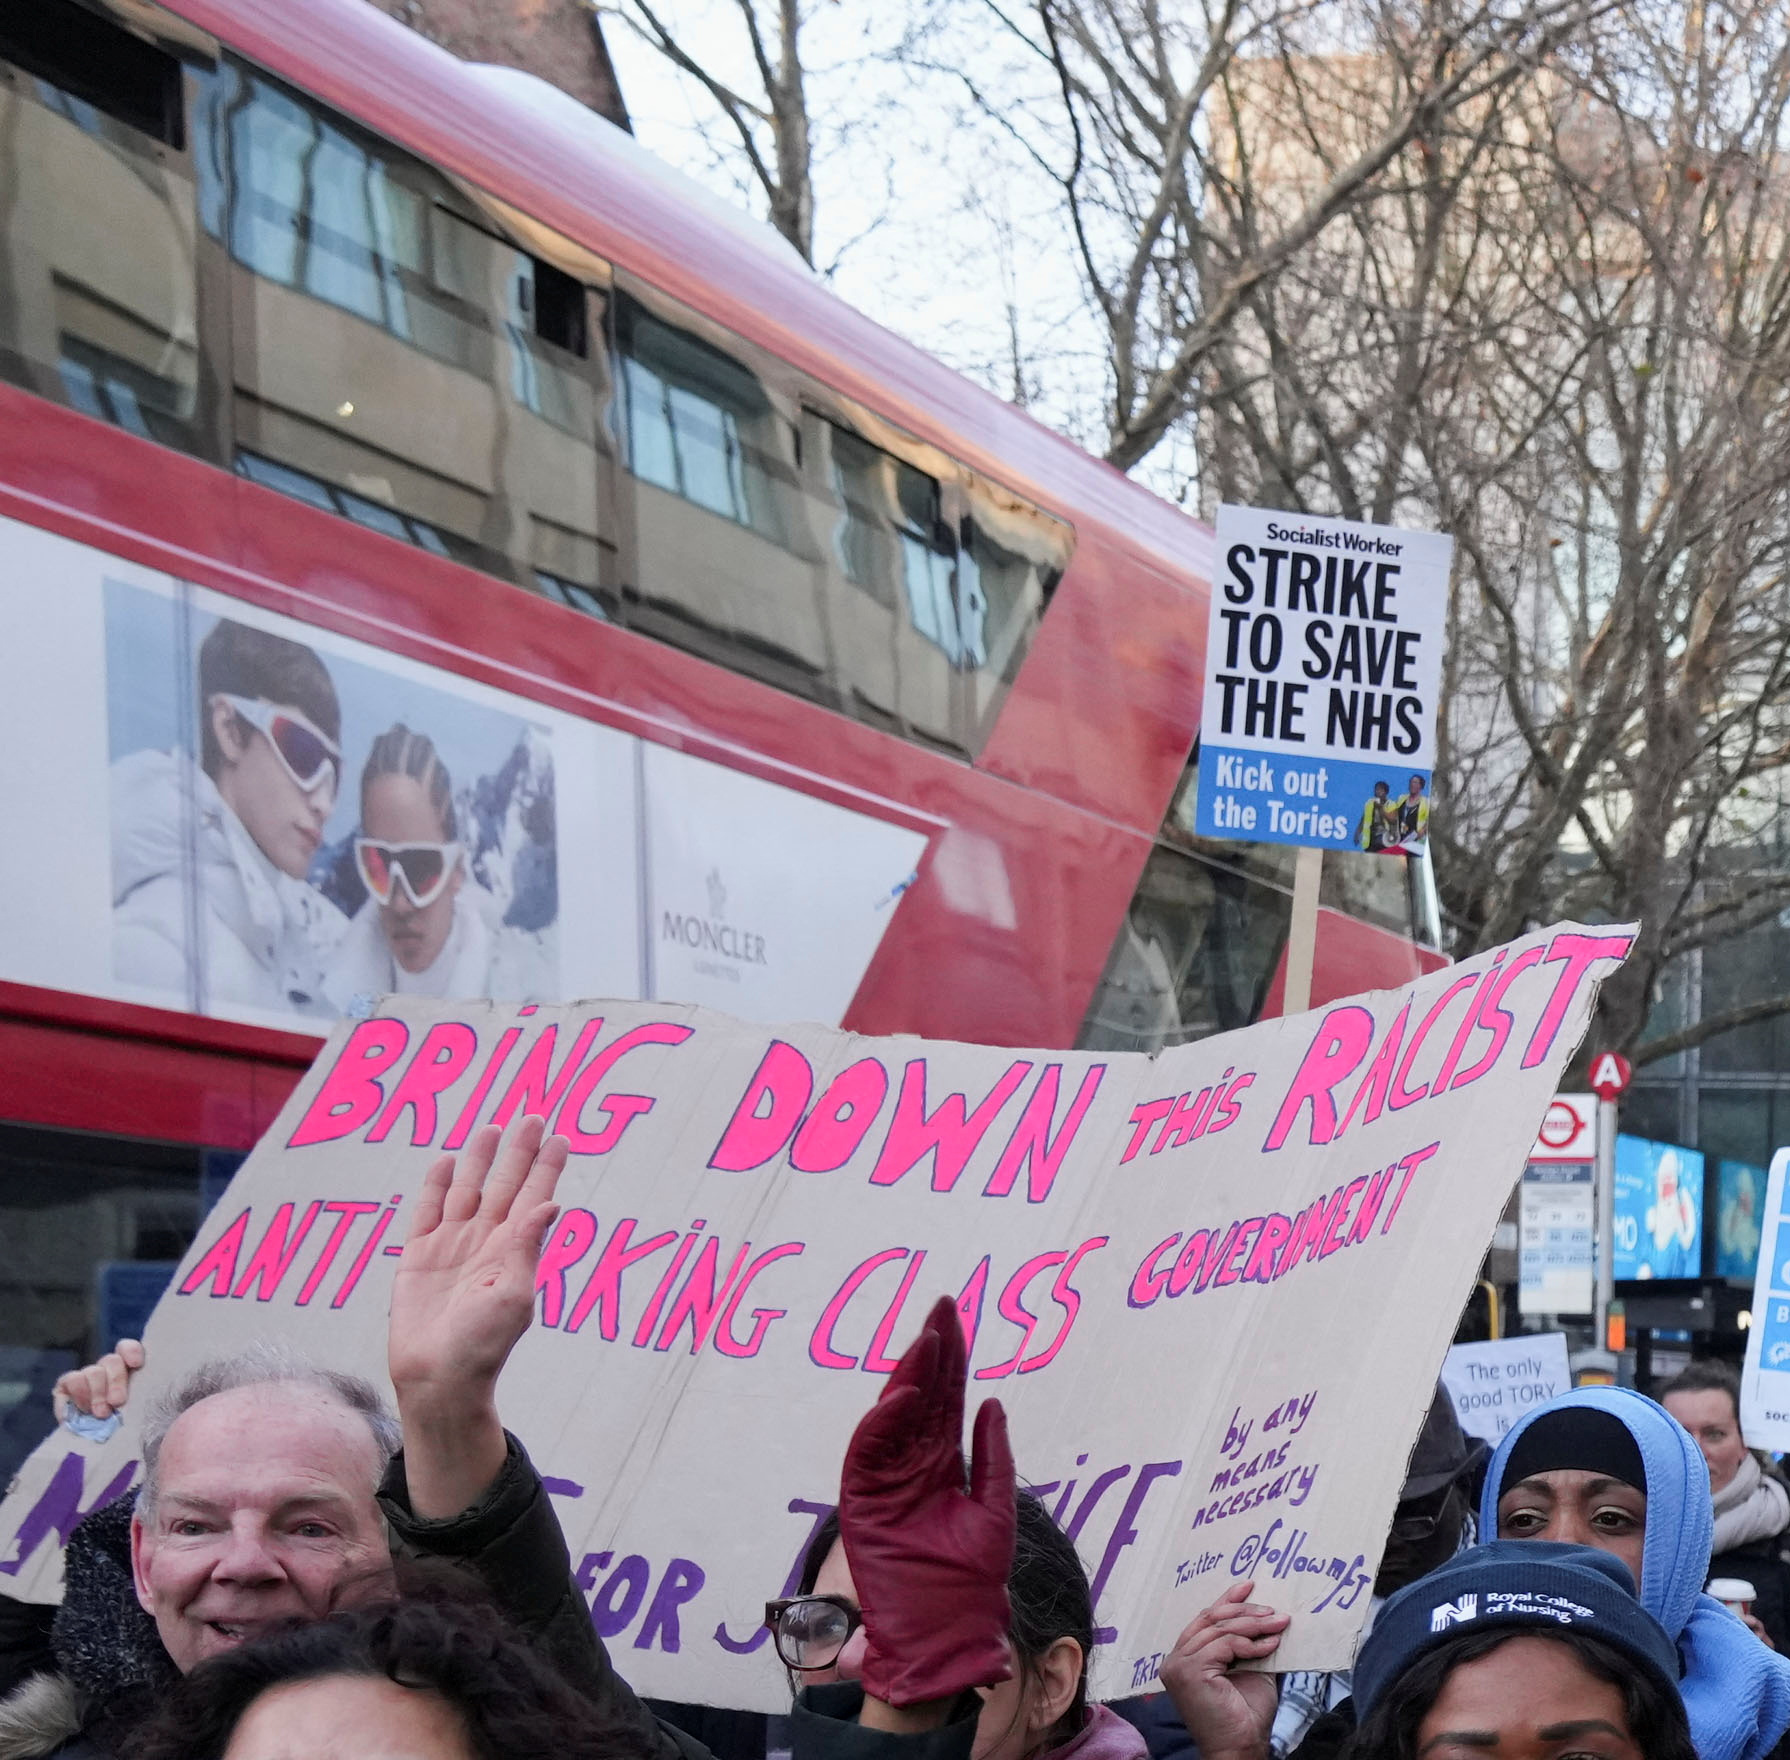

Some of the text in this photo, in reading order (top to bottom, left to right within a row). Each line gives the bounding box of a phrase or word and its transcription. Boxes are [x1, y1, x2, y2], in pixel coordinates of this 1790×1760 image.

[1267, 523, 1403, 557] Socialist Worker
[1223, 544, 1401, 624] STRIKE
[1220, 609, 1421, 691] TO SAVE
[1216, 675, 1423, 756] THE NHS
[1216, 755, 1328, 799] Kick out
[1213, 795, 1348, 839] the Tories
[663, 911, 768, 965] MONCLER
[286, 935, 1636, 1204] BRING DOWN THIS RACIST
[1593, 1054, 1622, 1088] A
[810, 1236, 1109, 1379] CLASS
[1128, 1141, 1440, 1308] GOVERNMENT
[1467, 1357, 1542, 1381] The only
[1459, 1382, 1556, 1413] good TORY
[1220, 1390, 1318, 1460] by any
[1209, 1440, 1292, 1495] means
[1192, 1464, 1320, 1529] necessary
[1175, 1551, 1224, 1588] Twitter
[1486, 1592, 1595, 1618] Royal College
[1486, 1603, 1572, 1624] of Nursing
